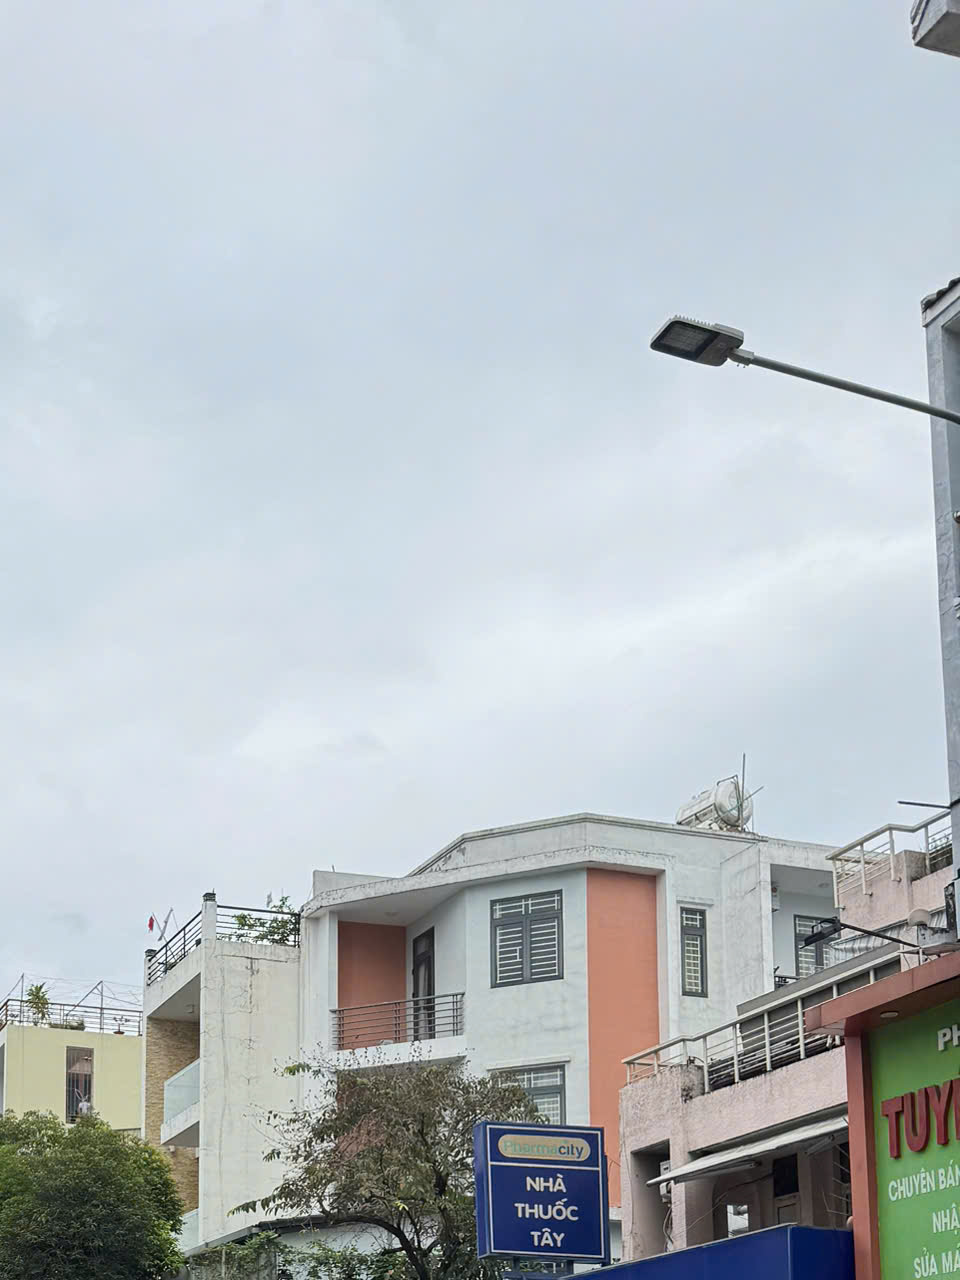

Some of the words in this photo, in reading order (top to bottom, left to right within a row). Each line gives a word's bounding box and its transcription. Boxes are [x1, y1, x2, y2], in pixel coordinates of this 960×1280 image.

[503, 1140, 584, 1159] Pharmacity
[525, 1173, 567, 1193] NHÀ
[888, 1167, 936, 1201] CHUYÊN
[514, 1198, 579, 1221] THUỐC
[530, 1228, 565, 1247] TÂY
[914, 1247, 938, 1279] SỬA
